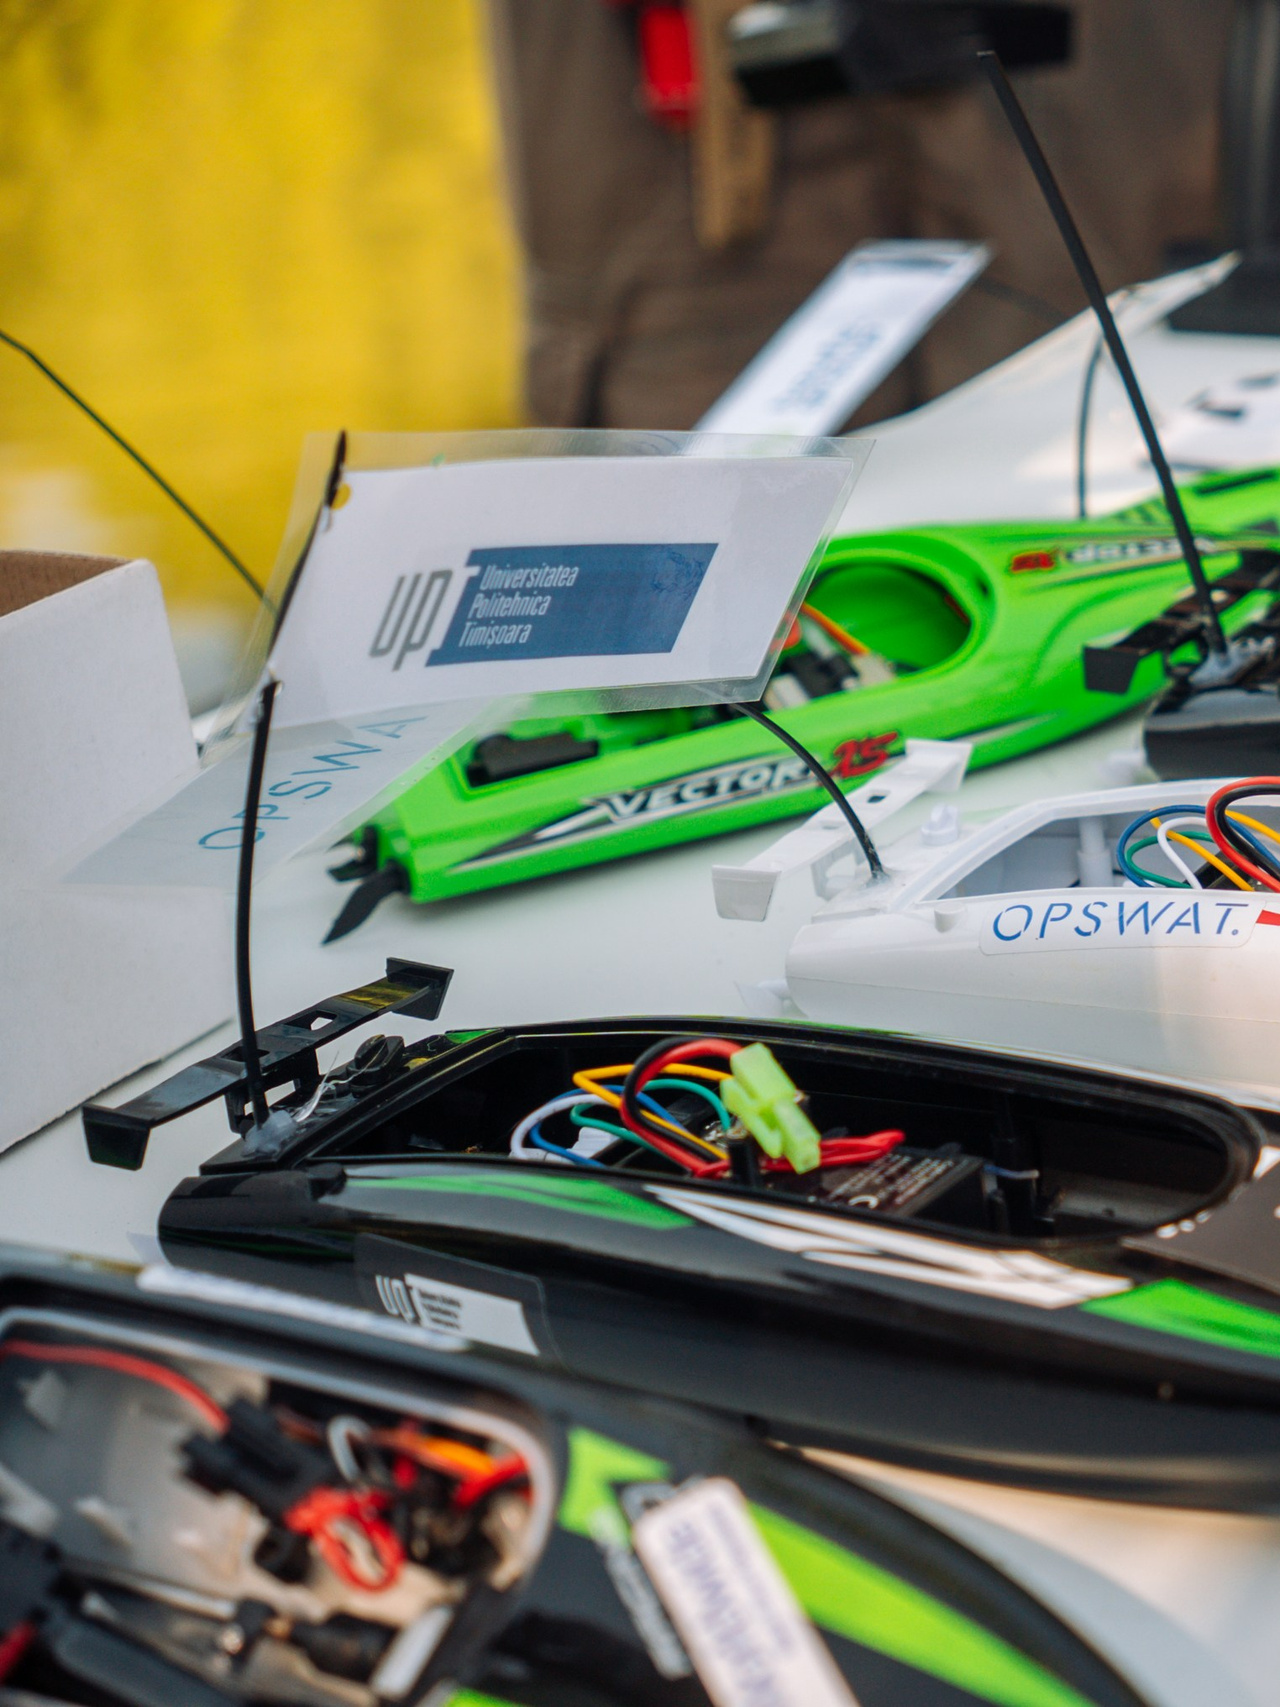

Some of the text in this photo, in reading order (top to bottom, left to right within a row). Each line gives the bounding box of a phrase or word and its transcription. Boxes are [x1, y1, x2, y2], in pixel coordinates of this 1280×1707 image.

[478, 563, 580, 592] Universitatea
[466, 590, 552, 620] Politehnica
[198, 714, 430, 851] OPSWA
[605, 760, 812, 818] VECTOR
